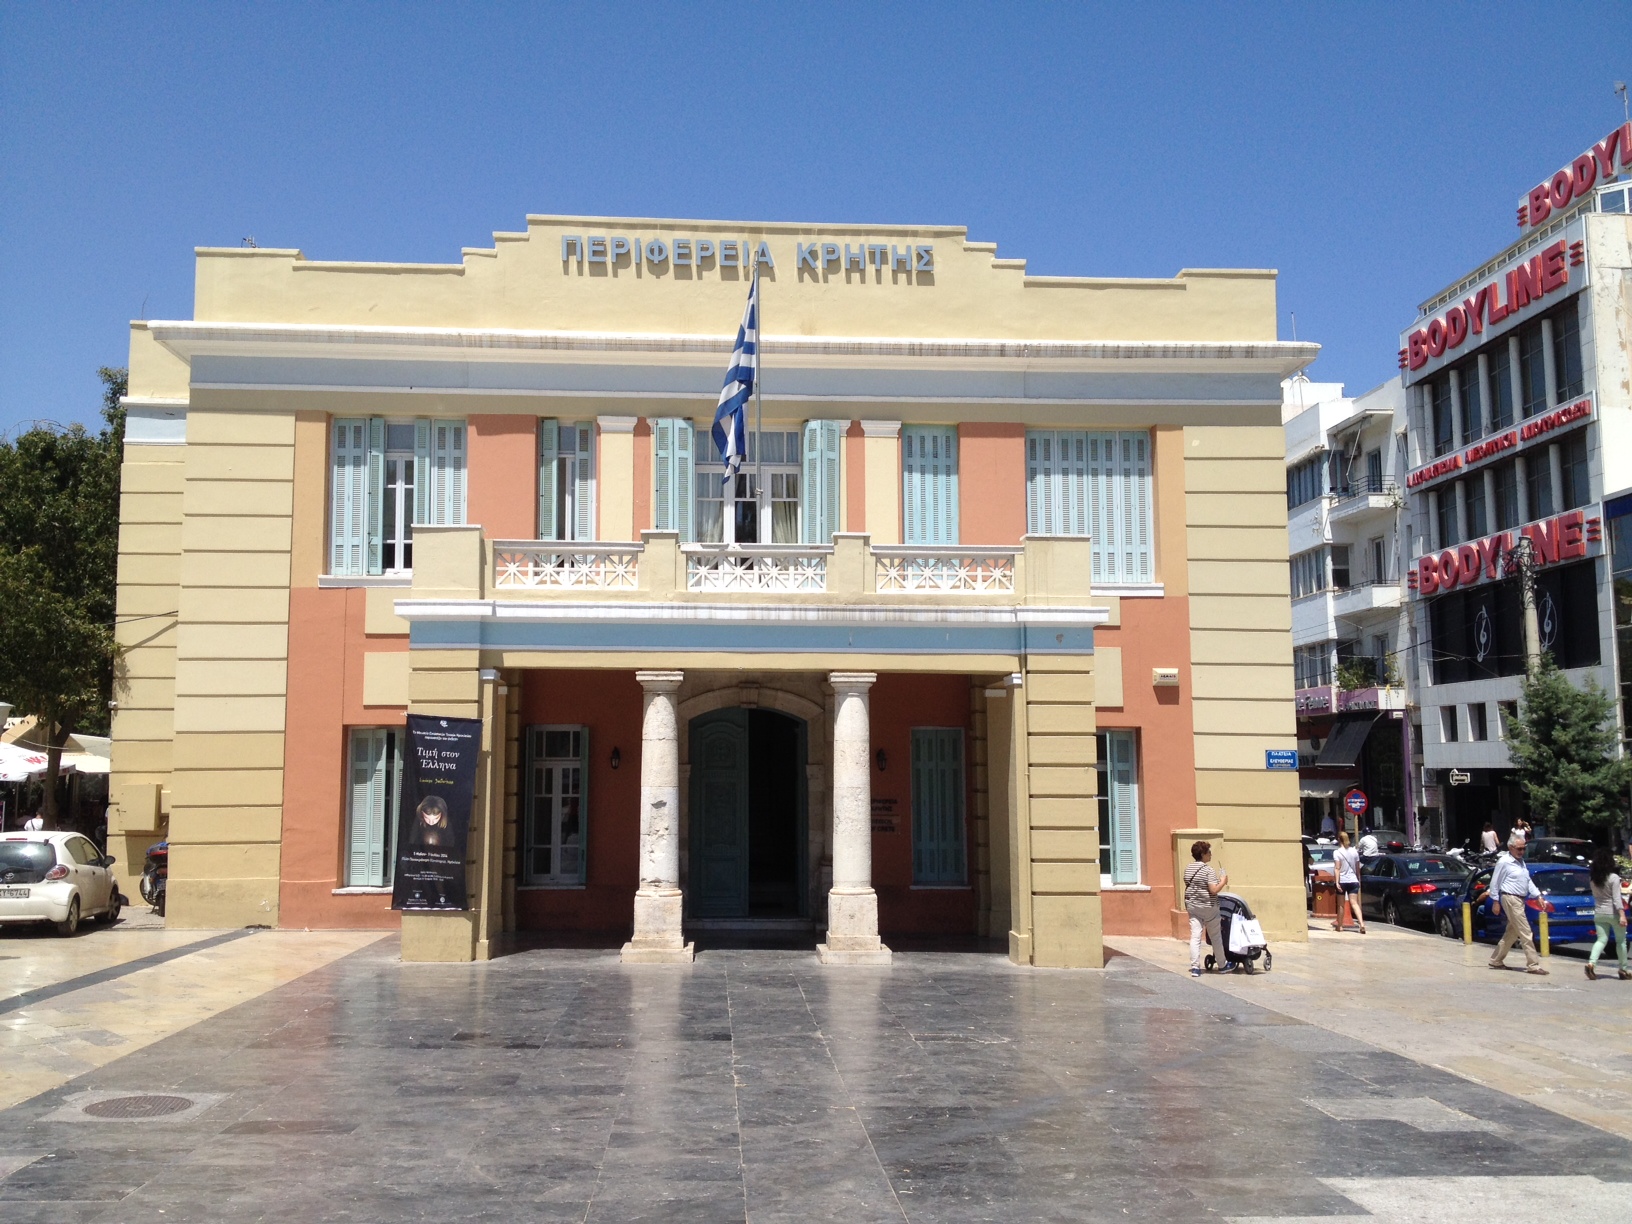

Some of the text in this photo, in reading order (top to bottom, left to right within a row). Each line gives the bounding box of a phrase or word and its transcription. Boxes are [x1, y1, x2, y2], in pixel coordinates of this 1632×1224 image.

[561, 234, 935, 271] ΠΕΡΙΦΕΡΕΙΑ ΚΡΗΤΗΣ
[1408, 239, 1568, 371] BODYLINE
[416, 746, 460, 759] Τιμή στον
[420, 759, 457, 771] Έλληνα
